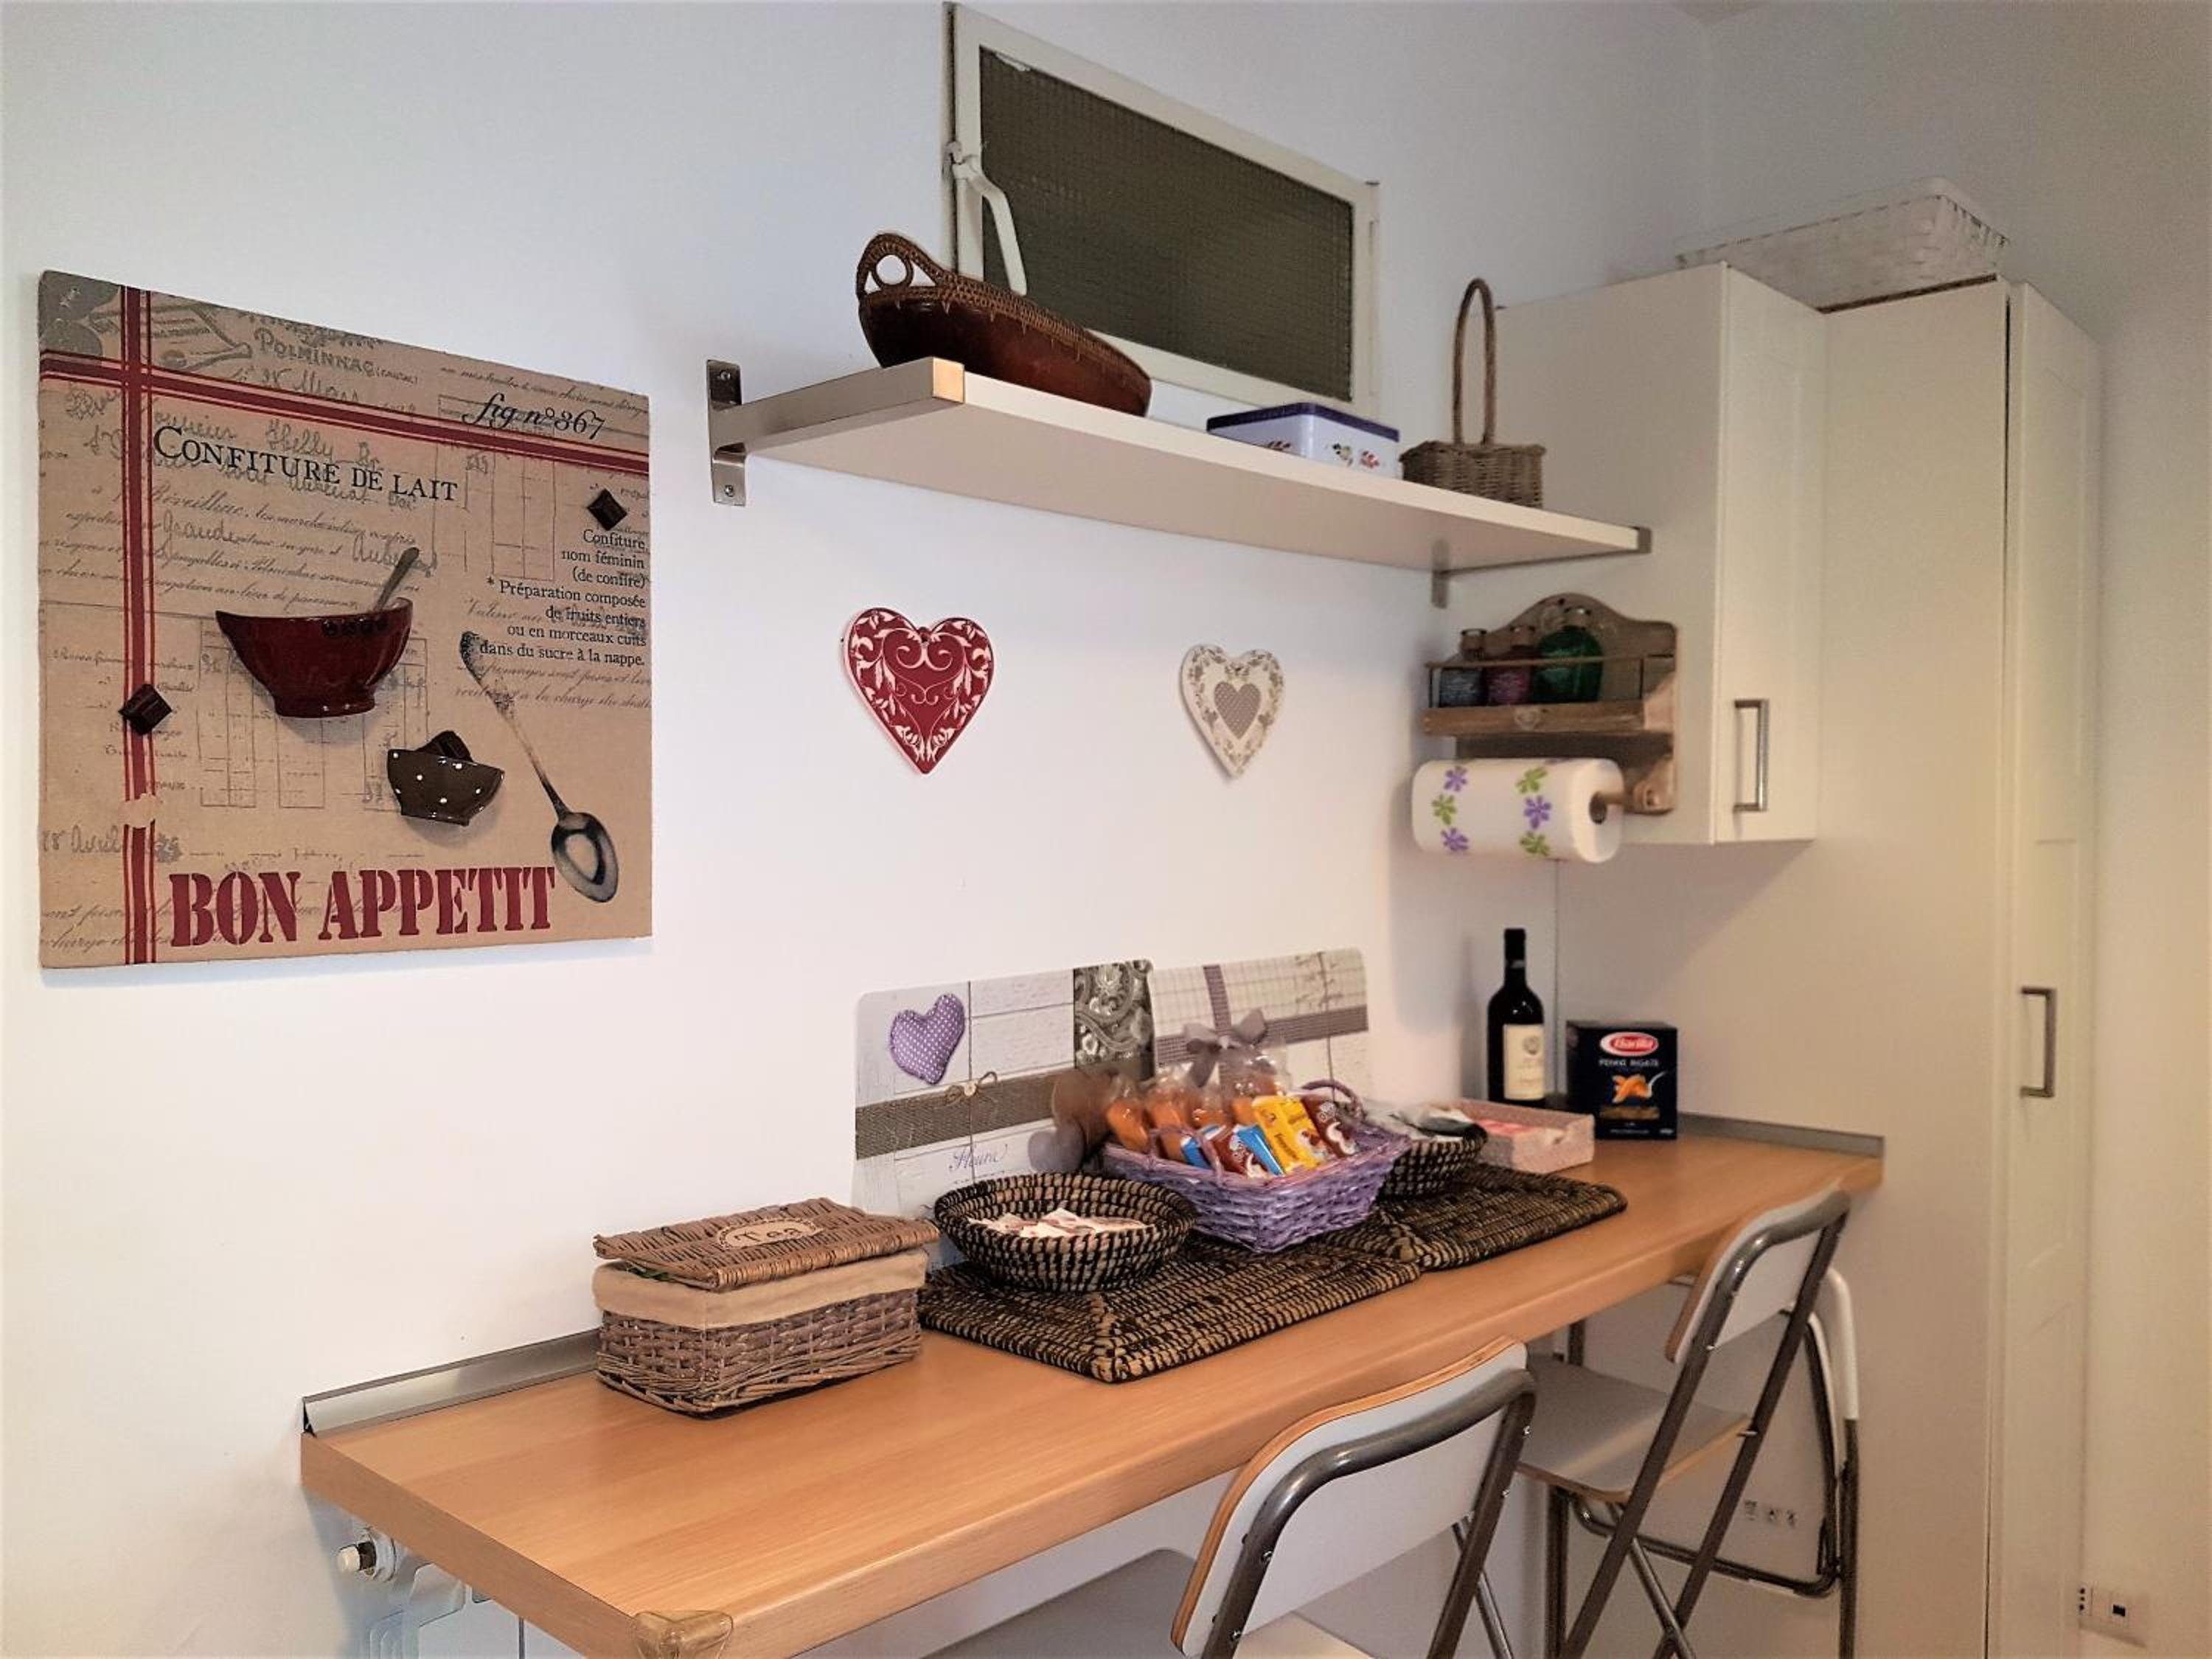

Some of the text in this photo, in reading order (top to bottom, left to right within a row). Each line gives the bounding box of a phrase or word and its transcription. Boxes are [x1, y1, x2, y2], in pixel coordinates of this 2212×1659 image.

[153, 425, 341, 484] CONFITURE
[351, 467, 383, 492] DE
[392, 473, 459, 501] LAIT
[561, 550, 644, 568] nom féminin
[573, 566, 646, 589] (de confire)
[499, 579, 647, 608] Préparation composée
[546, 605, 563, 619] de
[566, 605, 602, 623] fruits
[605, 611, 646, 630] entiers
[507, 625, 647, 647] ou en morceaux cuits
[479, 639, 514, 656] dans
[517, 642, 535, 658] du
[539, 646, 574, 661] sucre
[577, 647, 585, 662] à
[588, 647, 601, 662] la
[168, 866, 555, 947] BON APPETIT
